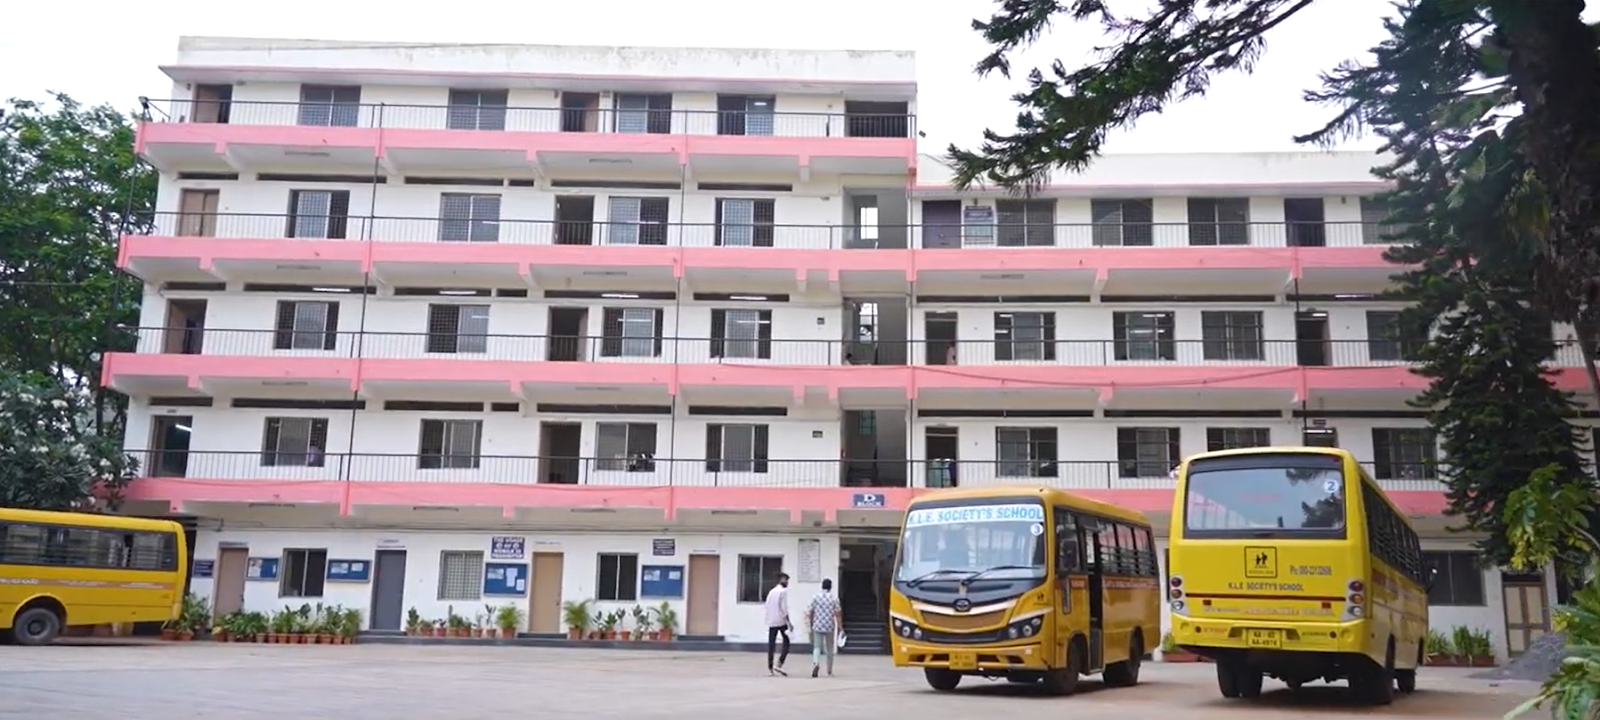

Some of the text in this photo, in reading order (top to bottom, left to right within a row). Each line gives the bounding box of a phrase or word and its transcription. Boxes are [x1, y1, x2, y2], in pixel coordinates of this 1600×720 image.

[1327, 481, 1336, 491] 2
[864, 493, 877, 501] D
[937, 508, 993, 522] SOCIETY'S
[998, 506, 1043, 520] SCHOOL
[1279, 583, 1304, 591] SCHOOL
